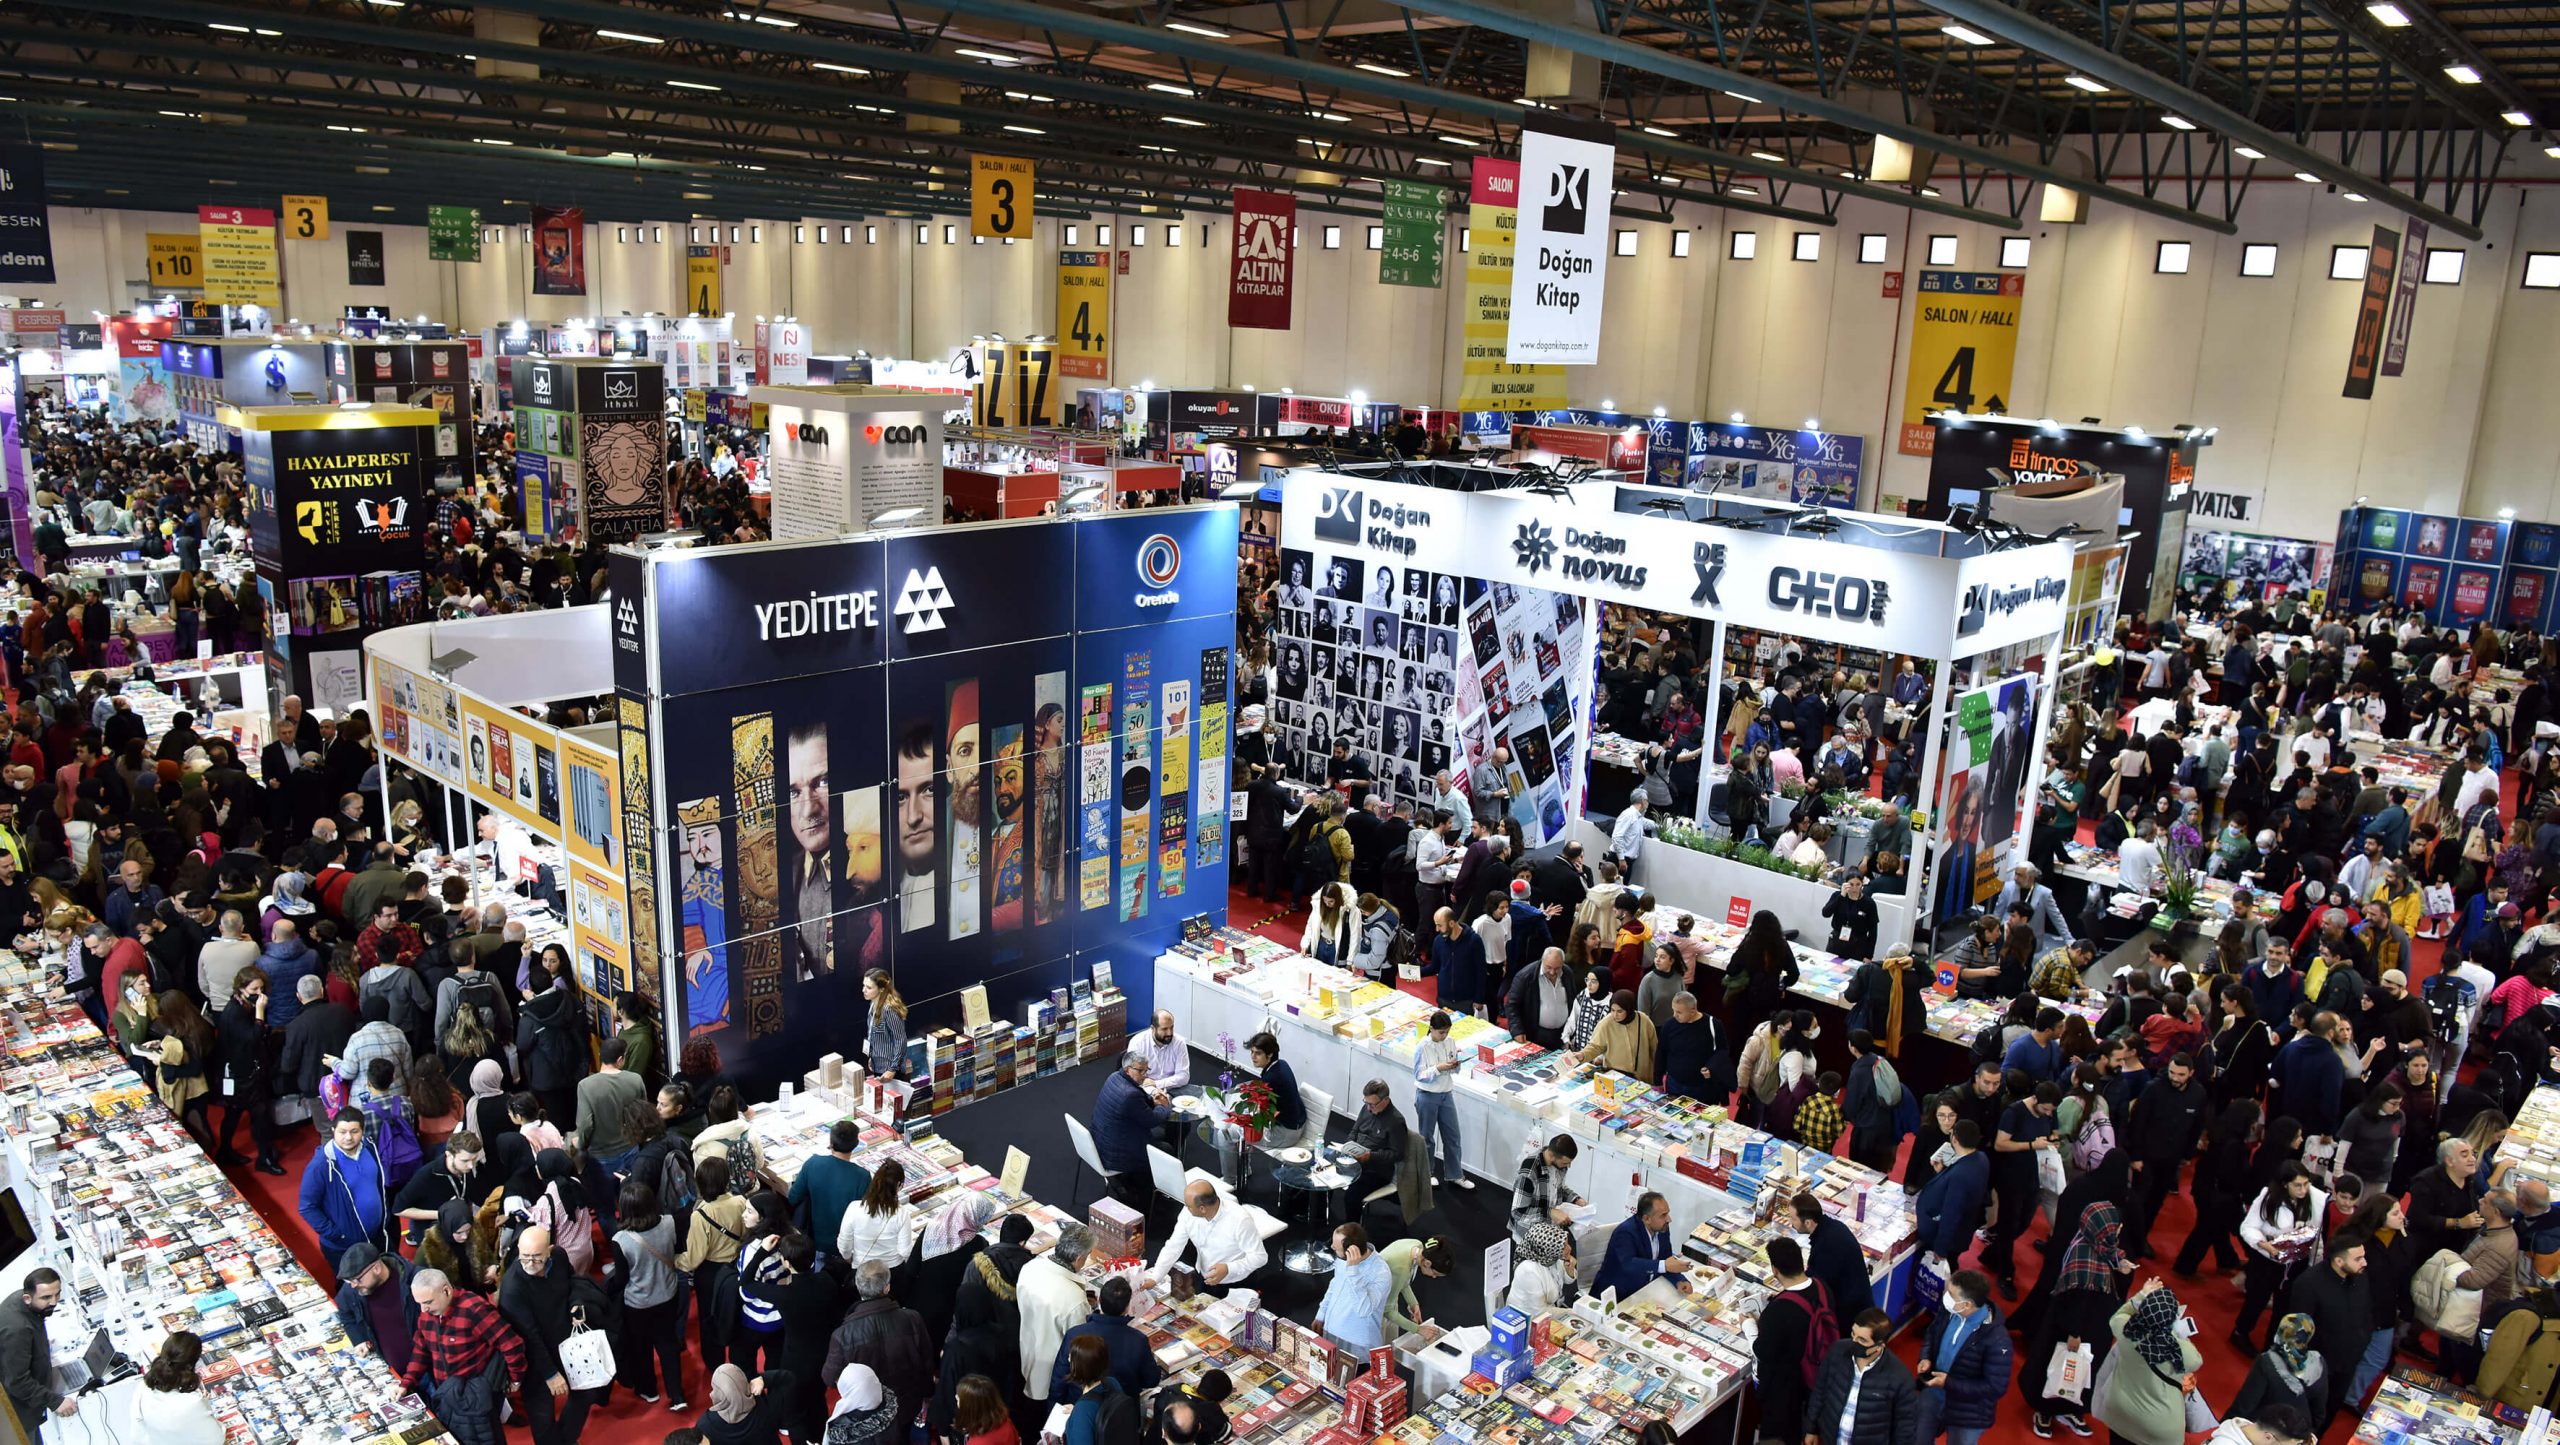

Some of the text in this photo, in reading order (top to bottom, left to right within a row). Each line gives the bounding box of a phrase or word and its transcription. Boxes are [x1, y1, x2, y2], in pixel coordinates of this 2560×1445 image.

[979, 160, 1004, 171] SALON
[1009, 163, 1027, 174] HALL
[1394, 183, 1402, 197] 2
[1488, 176, 1513, 193] SALON
[990, 178, 1015, 233] 3
[231, 210, 243, 225] 3
[297, 207, 315, 238] 3
[1496, 213, 1517, 230] KÜLTÜ
[0, 251, 45, 267] dem
[1392, 247, 1420, 262] 4-5-6
[1539, 247, 1593, 279] Doğan
[169, 255, 192, 276] 10
[1237, 261, 1285, 283] ALTIN
[1063, 275, 1084, 286] SALON
[1089, 277, 1105, 287] HALL
[1236, 282, 1284, 297] KİTAPLAR
[698, 284, 709, 318] 4
[1536, 281, 1580, 314] Kitap
[1071, 301, 1091, 351] 4
[1924, 307, 1968, 323] SALON
[1980, 311, 2014, 326] HALL
[1511, 363, 1521, 375] 10
[1933, 346, 1976, 414] 4
[534, 394, 552, 405] ithaki
[604, 398, 639, 409] ithaki
[1188, 404, 1217, 413] okuyan
[799, 423, 829, 445] can
[884, 424, 928, 445] can
[288, 452, 412, 471] HAYALPEREST
[1820, 459, 1837, 468] Yayın
[2030, 450, 2079, 478] timaş
[309, 469, 393, 490] YAYINEVİ
[1368, 497, 1430, 528] Doğan
[1367, 525, 1417, 556] Kitap
[1564, 526, 1627, 554] Doğan
[1563, 553, 1648, 590] novus
[1135, 591, 1180, 609] Orenda
[1992, 575, 2067, 616] Doğan Kitap
[755, 589, 879, 640] YEDİTEPE
[618, 636, 639, 653] YEDİTEPE
[1169, 690, 1187, 703] 101
[1129, 714, 1144, 730] 50
[1232, 809, 1243, 817] 325
[1166, 852, 1180, 866] 50
